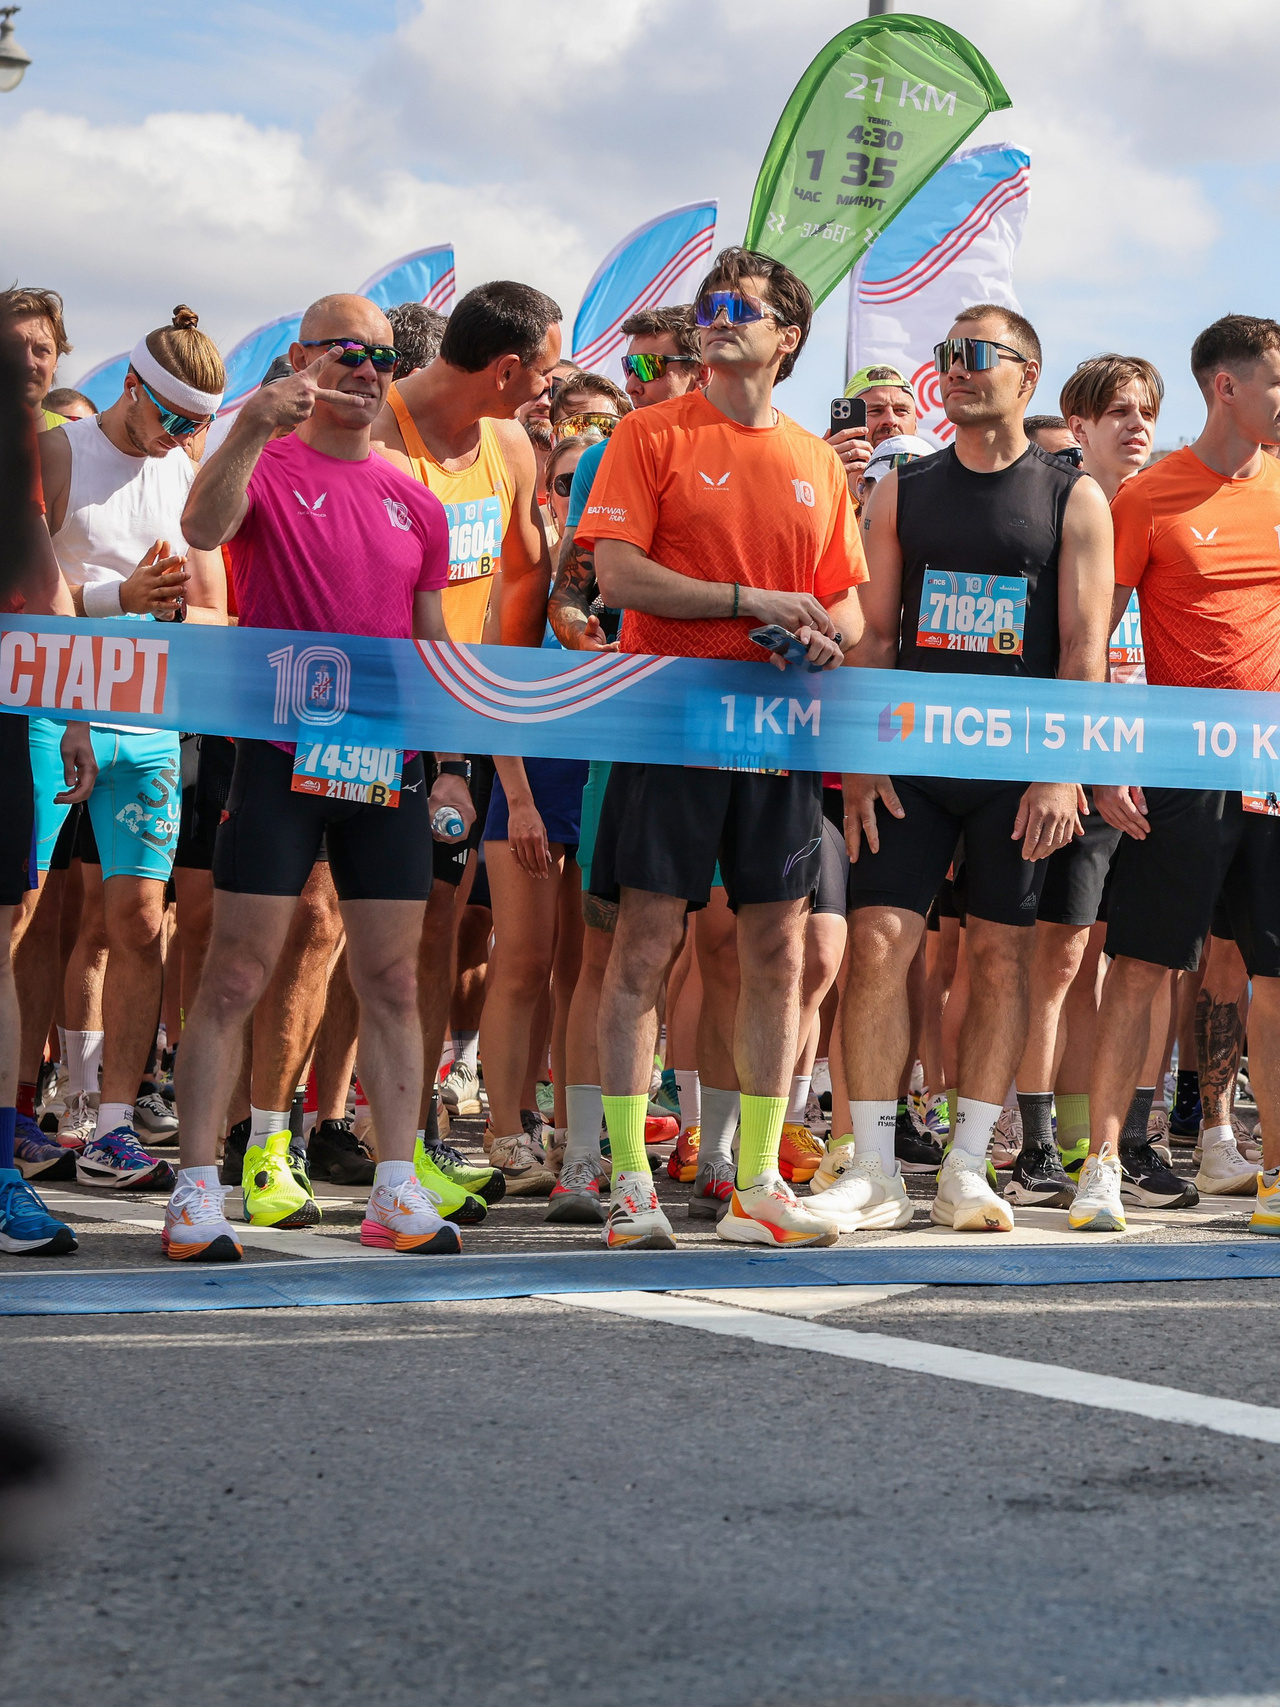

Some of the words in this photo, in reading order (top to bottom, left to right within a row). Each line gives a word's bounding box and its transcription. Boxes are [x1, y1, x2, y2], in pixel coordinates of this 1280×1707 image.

[844, 73, 885, 103] 21
[899, 81, 958, 116] КМ
[847, 125, 904, 151] 4:30
[867, 116, 892, 127] ТЕМП:
[806, 150, 826, 181] 1
[840, 152, 899, 188] 35
[794, 187, 822, 203] ЧАС
[836, 194, 887, 211] МИНУТ
[449, 519, 495, 561] 1604
[930, 592, 1014, 634] 71826
[1, 631, 169, 714] СТАРТ
[267, 645, 351, 727] 10
[721, 695, 735, 732] 1
[754, 696, 821, 737] КМ
[924, 705, 1012, 747] ПСБ
[1042, 712, 1066, 750] 5
[1082, 715, 1144, 753] КМ
[1192, 720, 1237, 758] 10
[304, 740, 397, 785] 74390
